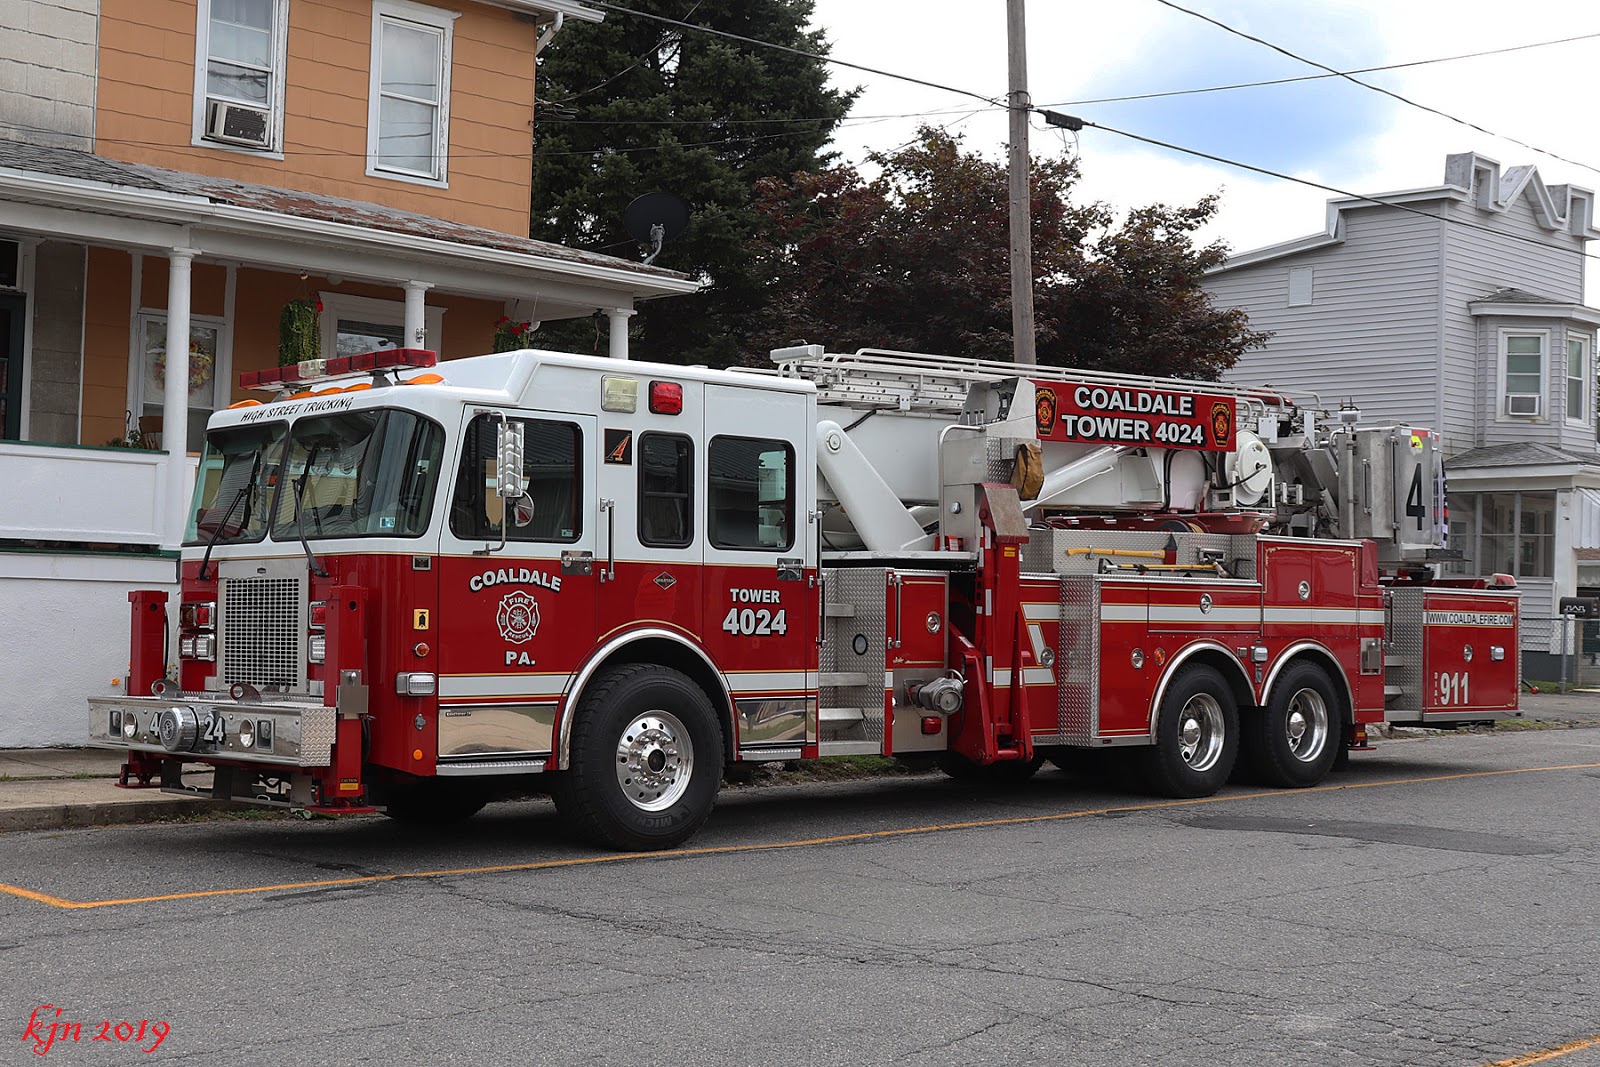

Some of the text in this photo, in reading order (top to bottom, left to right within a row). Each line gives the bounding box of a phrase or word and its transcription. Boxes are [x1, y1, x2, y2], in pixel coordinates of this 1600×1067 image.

[240, 397, 354, 422] HIGH STREET TRUCKING
[1074, 386, 1194, 417] COALDALE
[1062, 414, 1204, 445] TOWER 4024
[1406, 463, 1426, 531] 4
[470, 568, 562, 592] COALDALE
[508, 597, 530, 605] FIRE
[730, 588, 781, 604] TOWER
[722, 607, 788, 636] 4024
[1428, 613, 1514, 625] WWW.COALDALEFIRE.COM
[508, 631, 530, 640] RESCUE
[505, 651, 537, 665] PA.
[1440, 671, 1470, 706] 911
